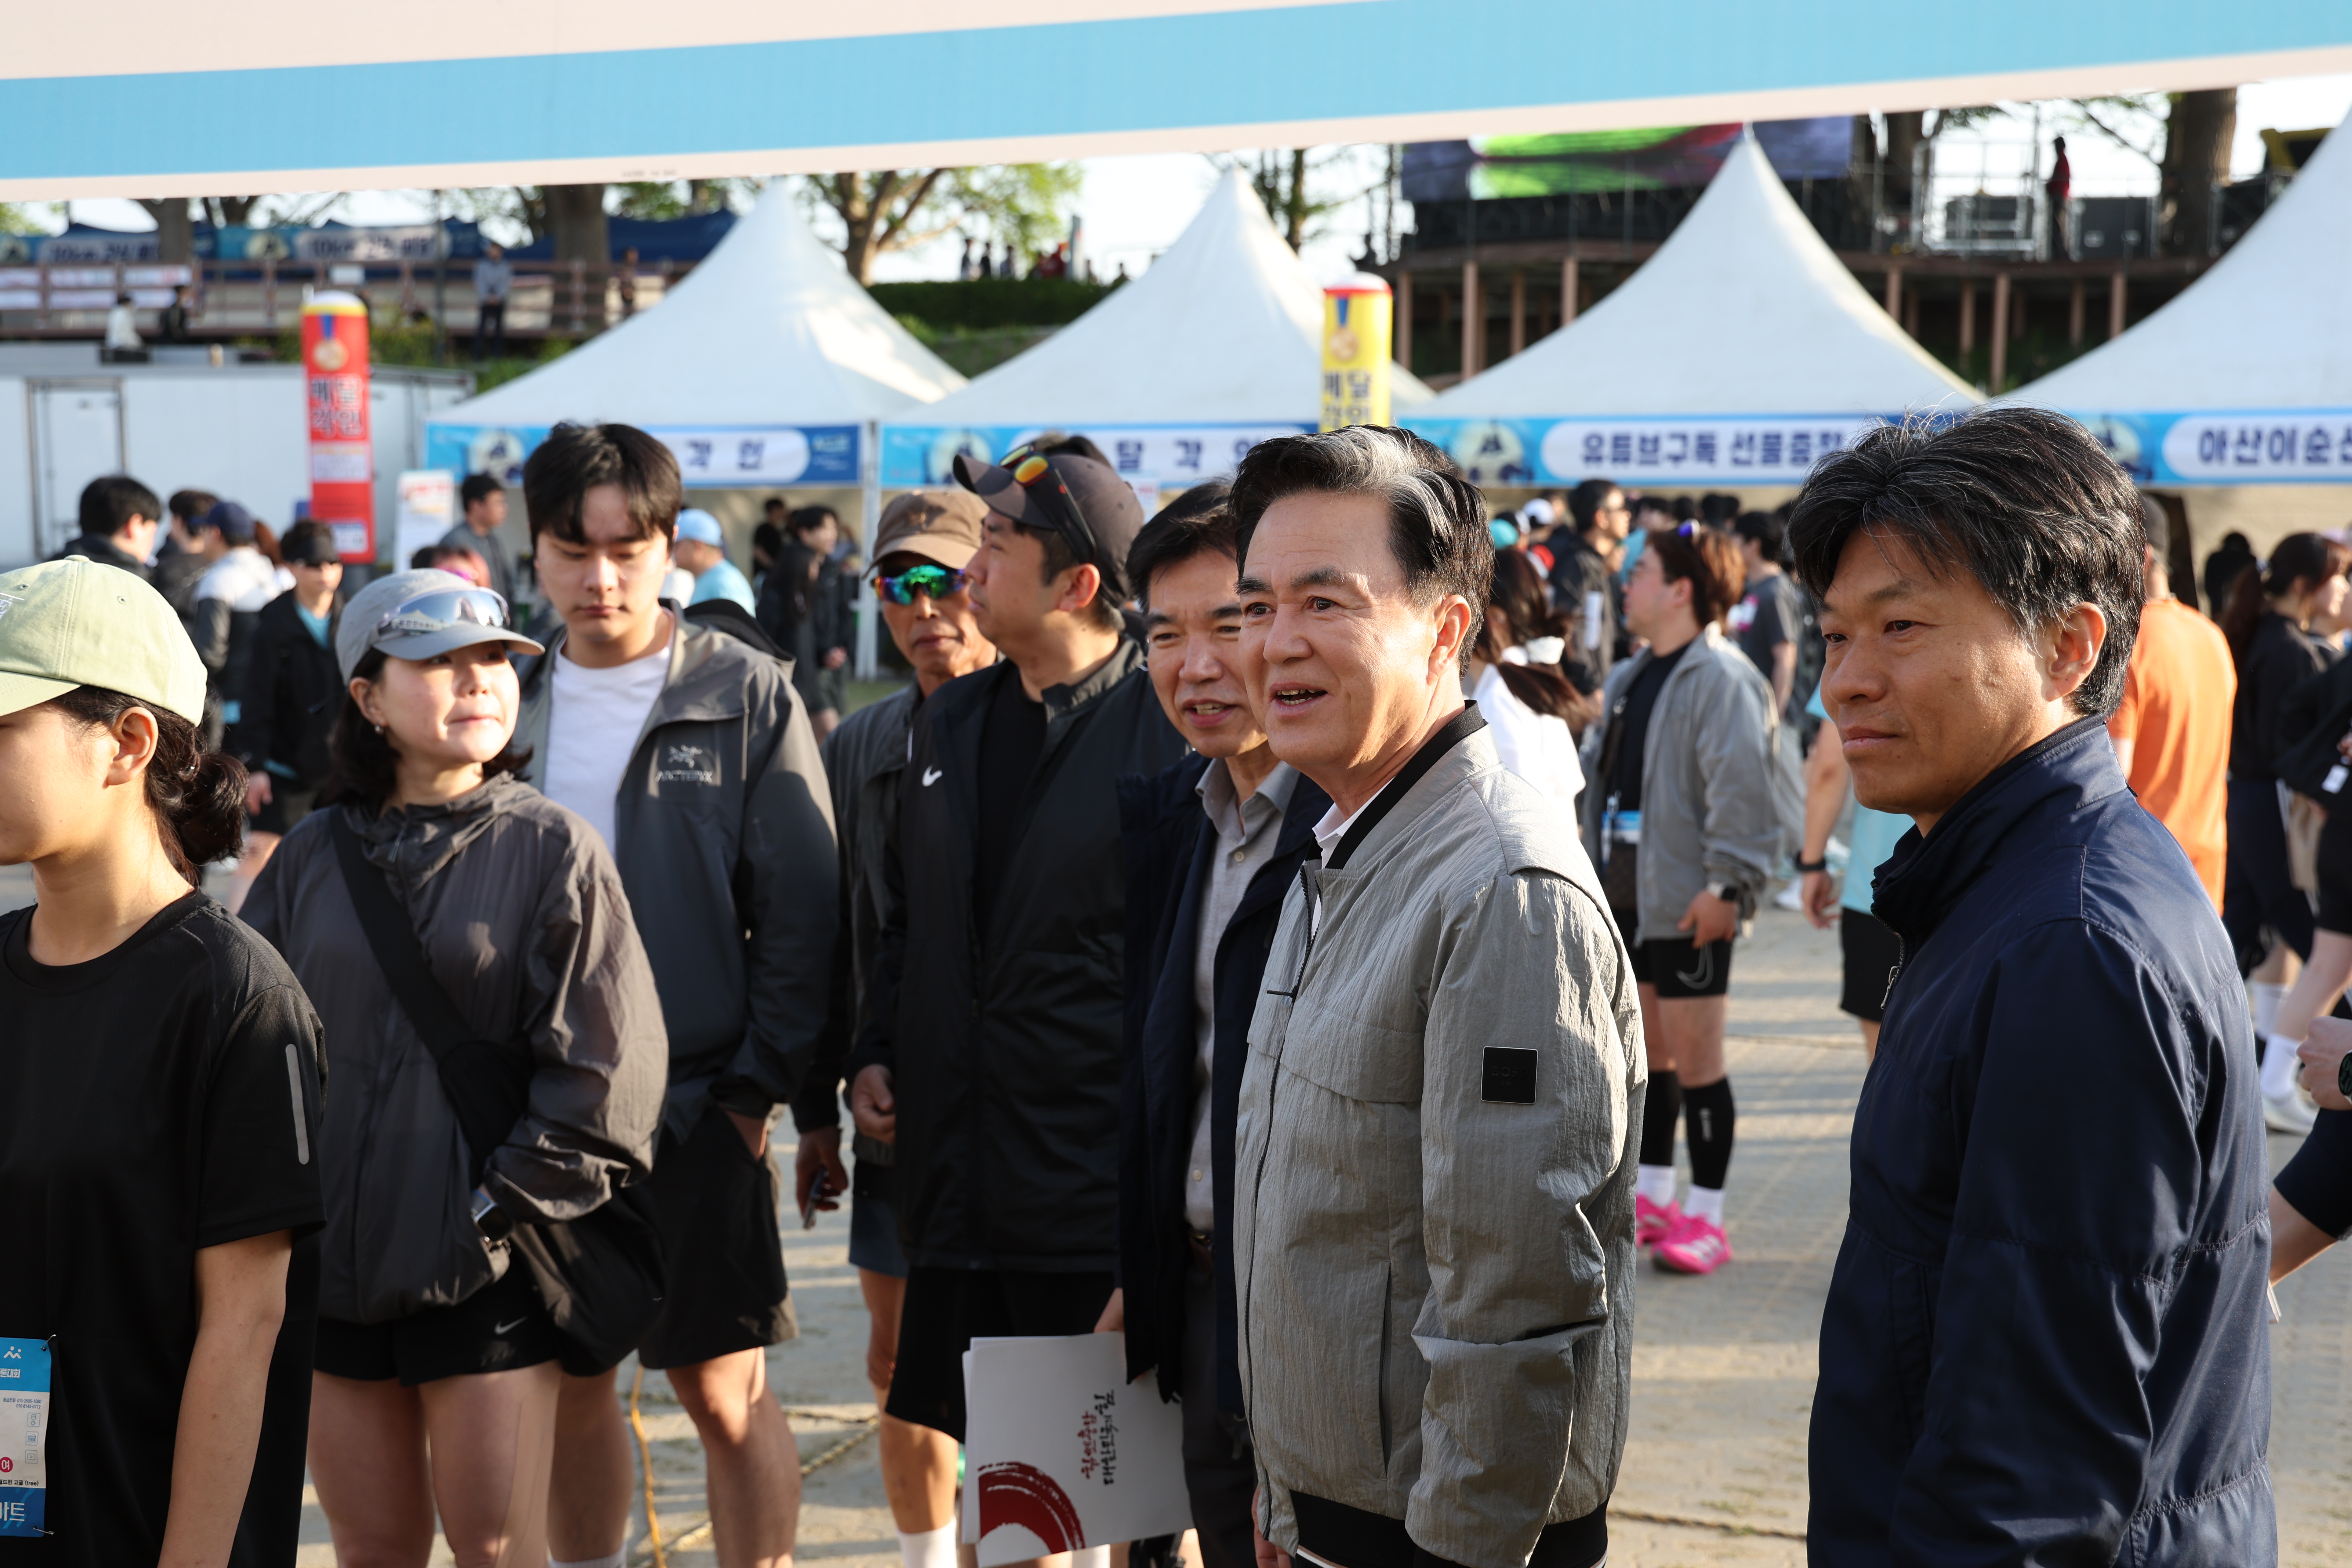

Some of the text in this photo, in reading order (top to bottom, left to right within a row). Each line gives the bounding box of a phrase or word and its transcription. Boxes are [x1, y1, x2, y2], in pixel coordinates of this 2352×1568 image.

[1584, 433, 1717, 466] 유튜브구독
[0, 1368, 21, 1378] 톤대회
[1, 1459, 10, 1470] 여
